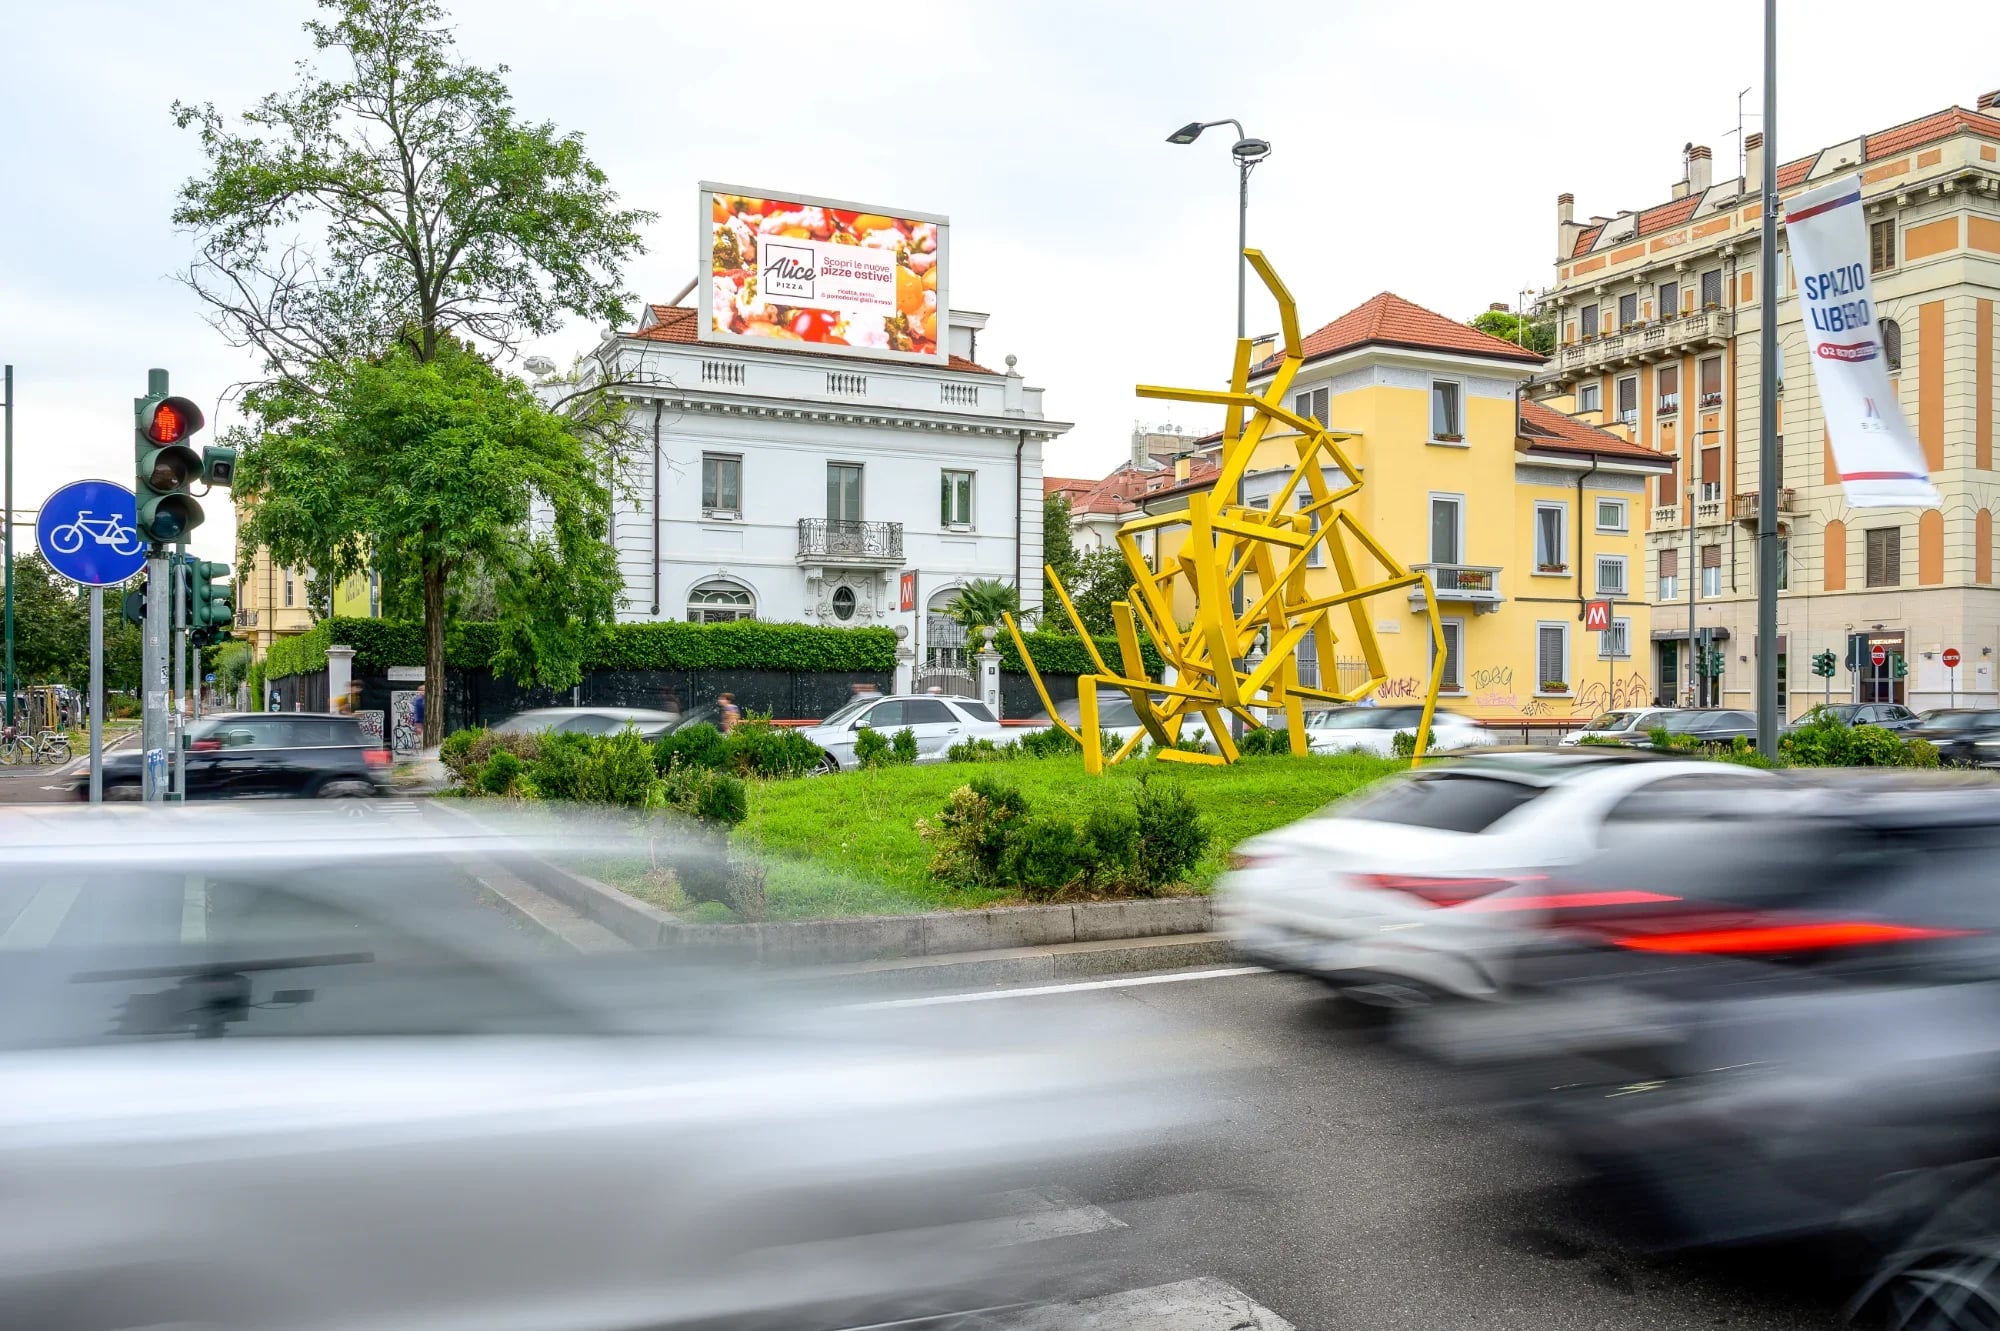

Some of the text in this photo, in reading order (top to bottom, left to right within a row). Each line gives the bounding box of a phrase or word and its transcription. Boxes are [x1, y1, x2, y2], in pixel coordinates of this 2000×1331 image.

[763, 257, 816, 280] Alice
[821, 266, 893, 283] pizze estive!
[824, 257, 890, 273] Scopri le nuove
[776, 281, 803, 290] PIZZA
[1804, 262, 1865, 300] SPAZIO
[1811, 299, 1870, 332] LIBERO
[902, 582, 912, 603] M
[1588, 607, 1607, 625] M
